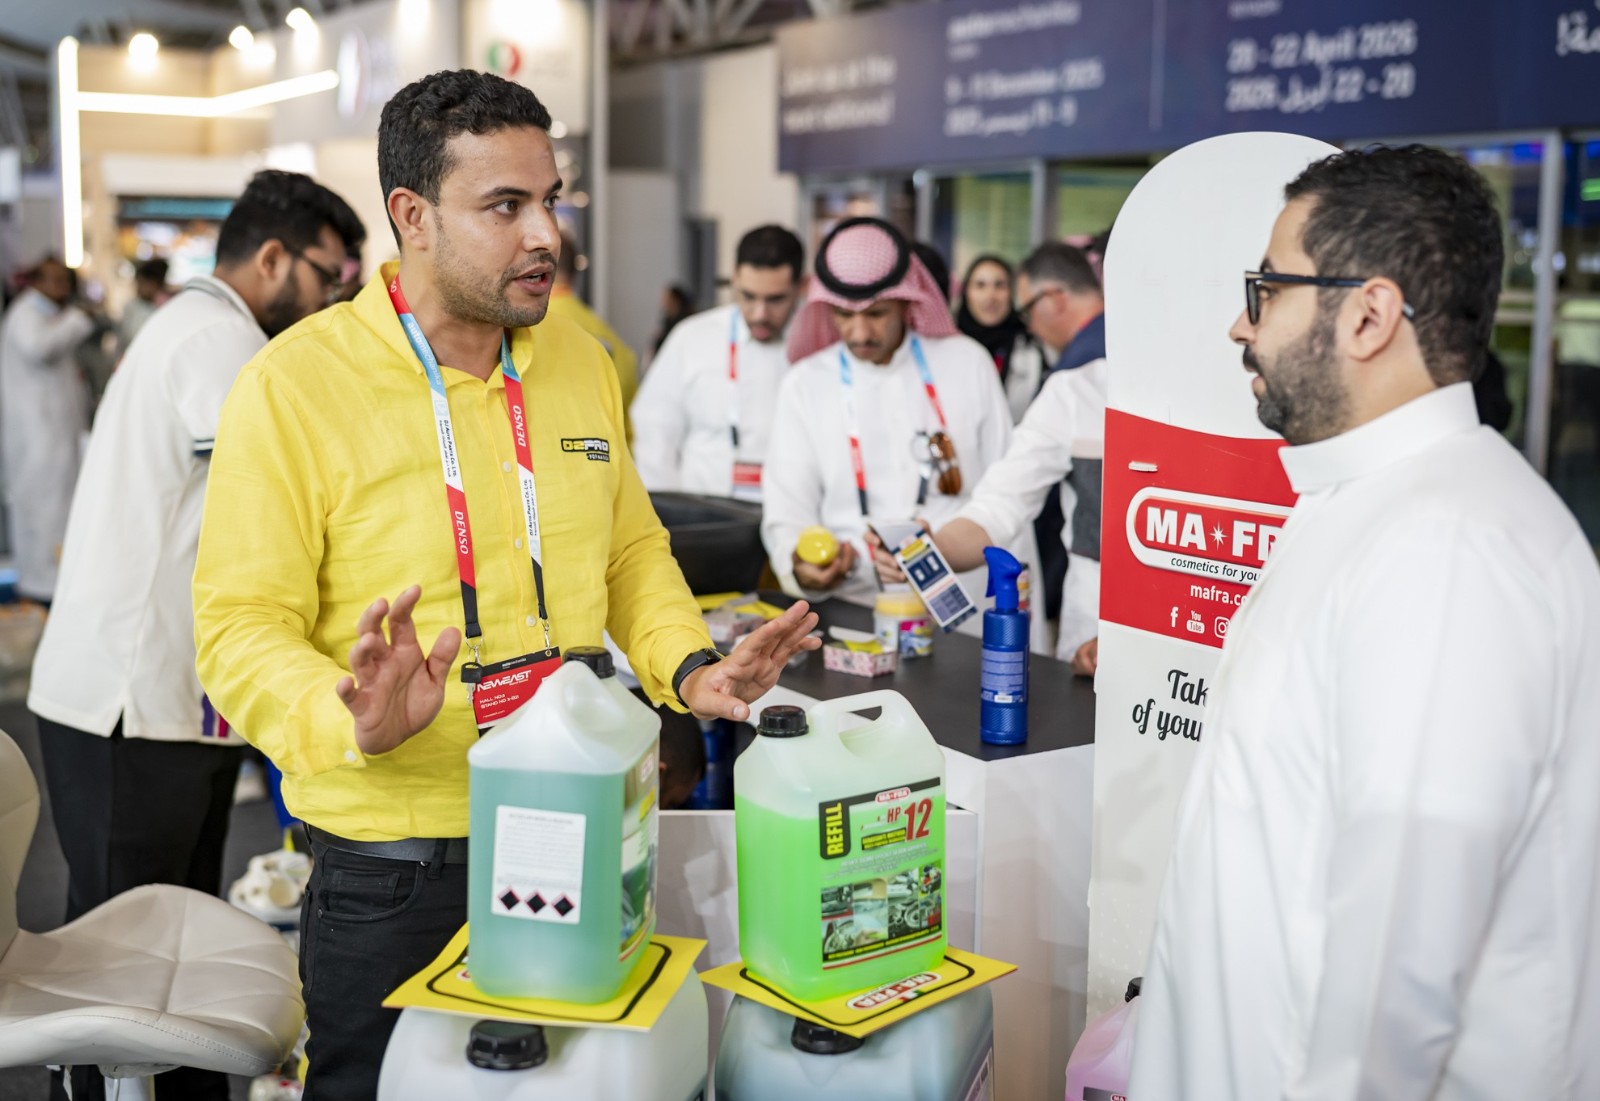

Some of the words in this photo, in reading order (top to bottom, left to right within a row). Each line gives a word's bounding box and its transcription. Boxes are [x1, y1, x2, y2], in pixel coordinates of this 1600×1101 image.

[1269, 33, 1302, 69] 22
[1302, 27, 1357, 67] April
[1357, 20, 1419, 58] 2026
[512, 405, 526, 447] DENSO
[455, 511, 469, 555] DENSO
[1170, 556, 1219, 574] cosmetics
[1222, 564, 1238, 577] for
[477, 670, 532, 692] NEWEAST
[1132, 698, 1156, 735] of
[825, 802, 844, 856] REFILL
[887, 806, 902, 823] HP
[904, 798, 932, 841] 12
